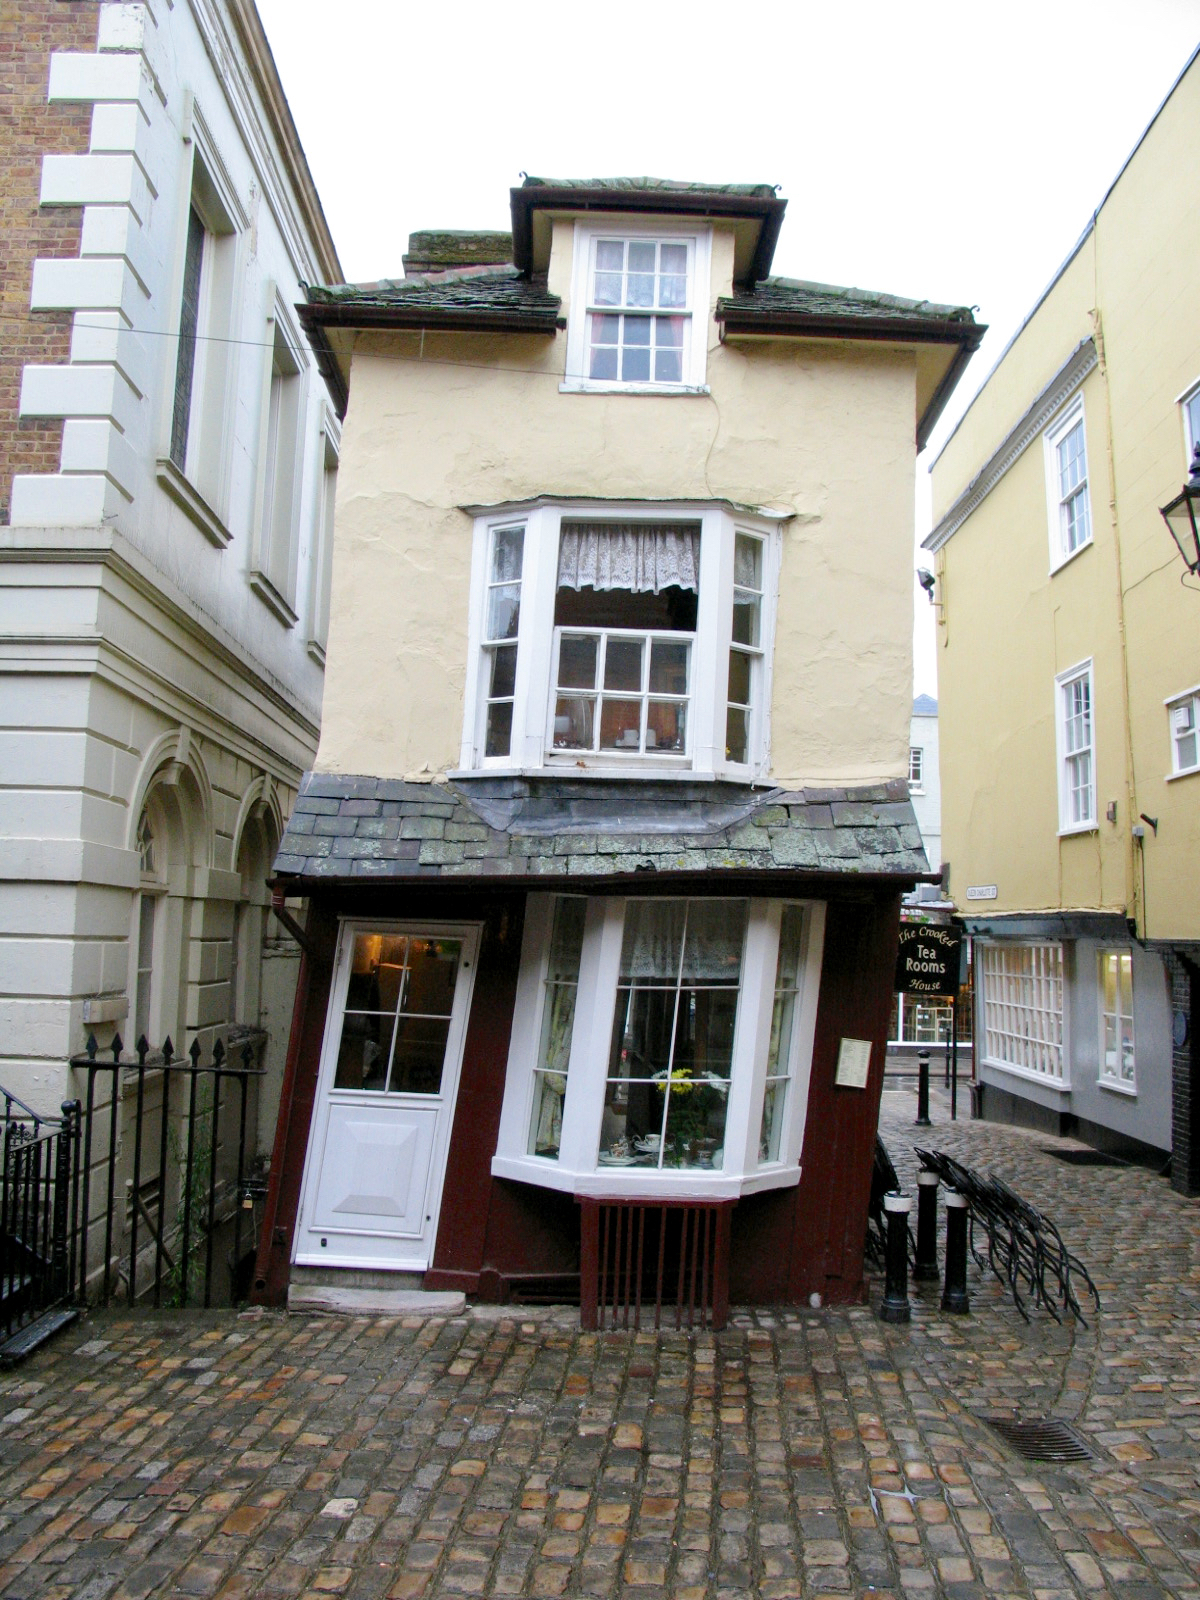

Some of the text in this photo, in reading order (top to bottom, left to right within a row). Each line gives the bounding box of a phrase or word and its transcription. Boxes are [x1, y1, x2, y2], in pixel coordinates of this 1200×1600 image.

[899, 926, 958, 947] The Crooked
[917, 944, 936, 959] Tea
[906, 957, 946, 973] Rooms
[908, 979, 941, 991] House
